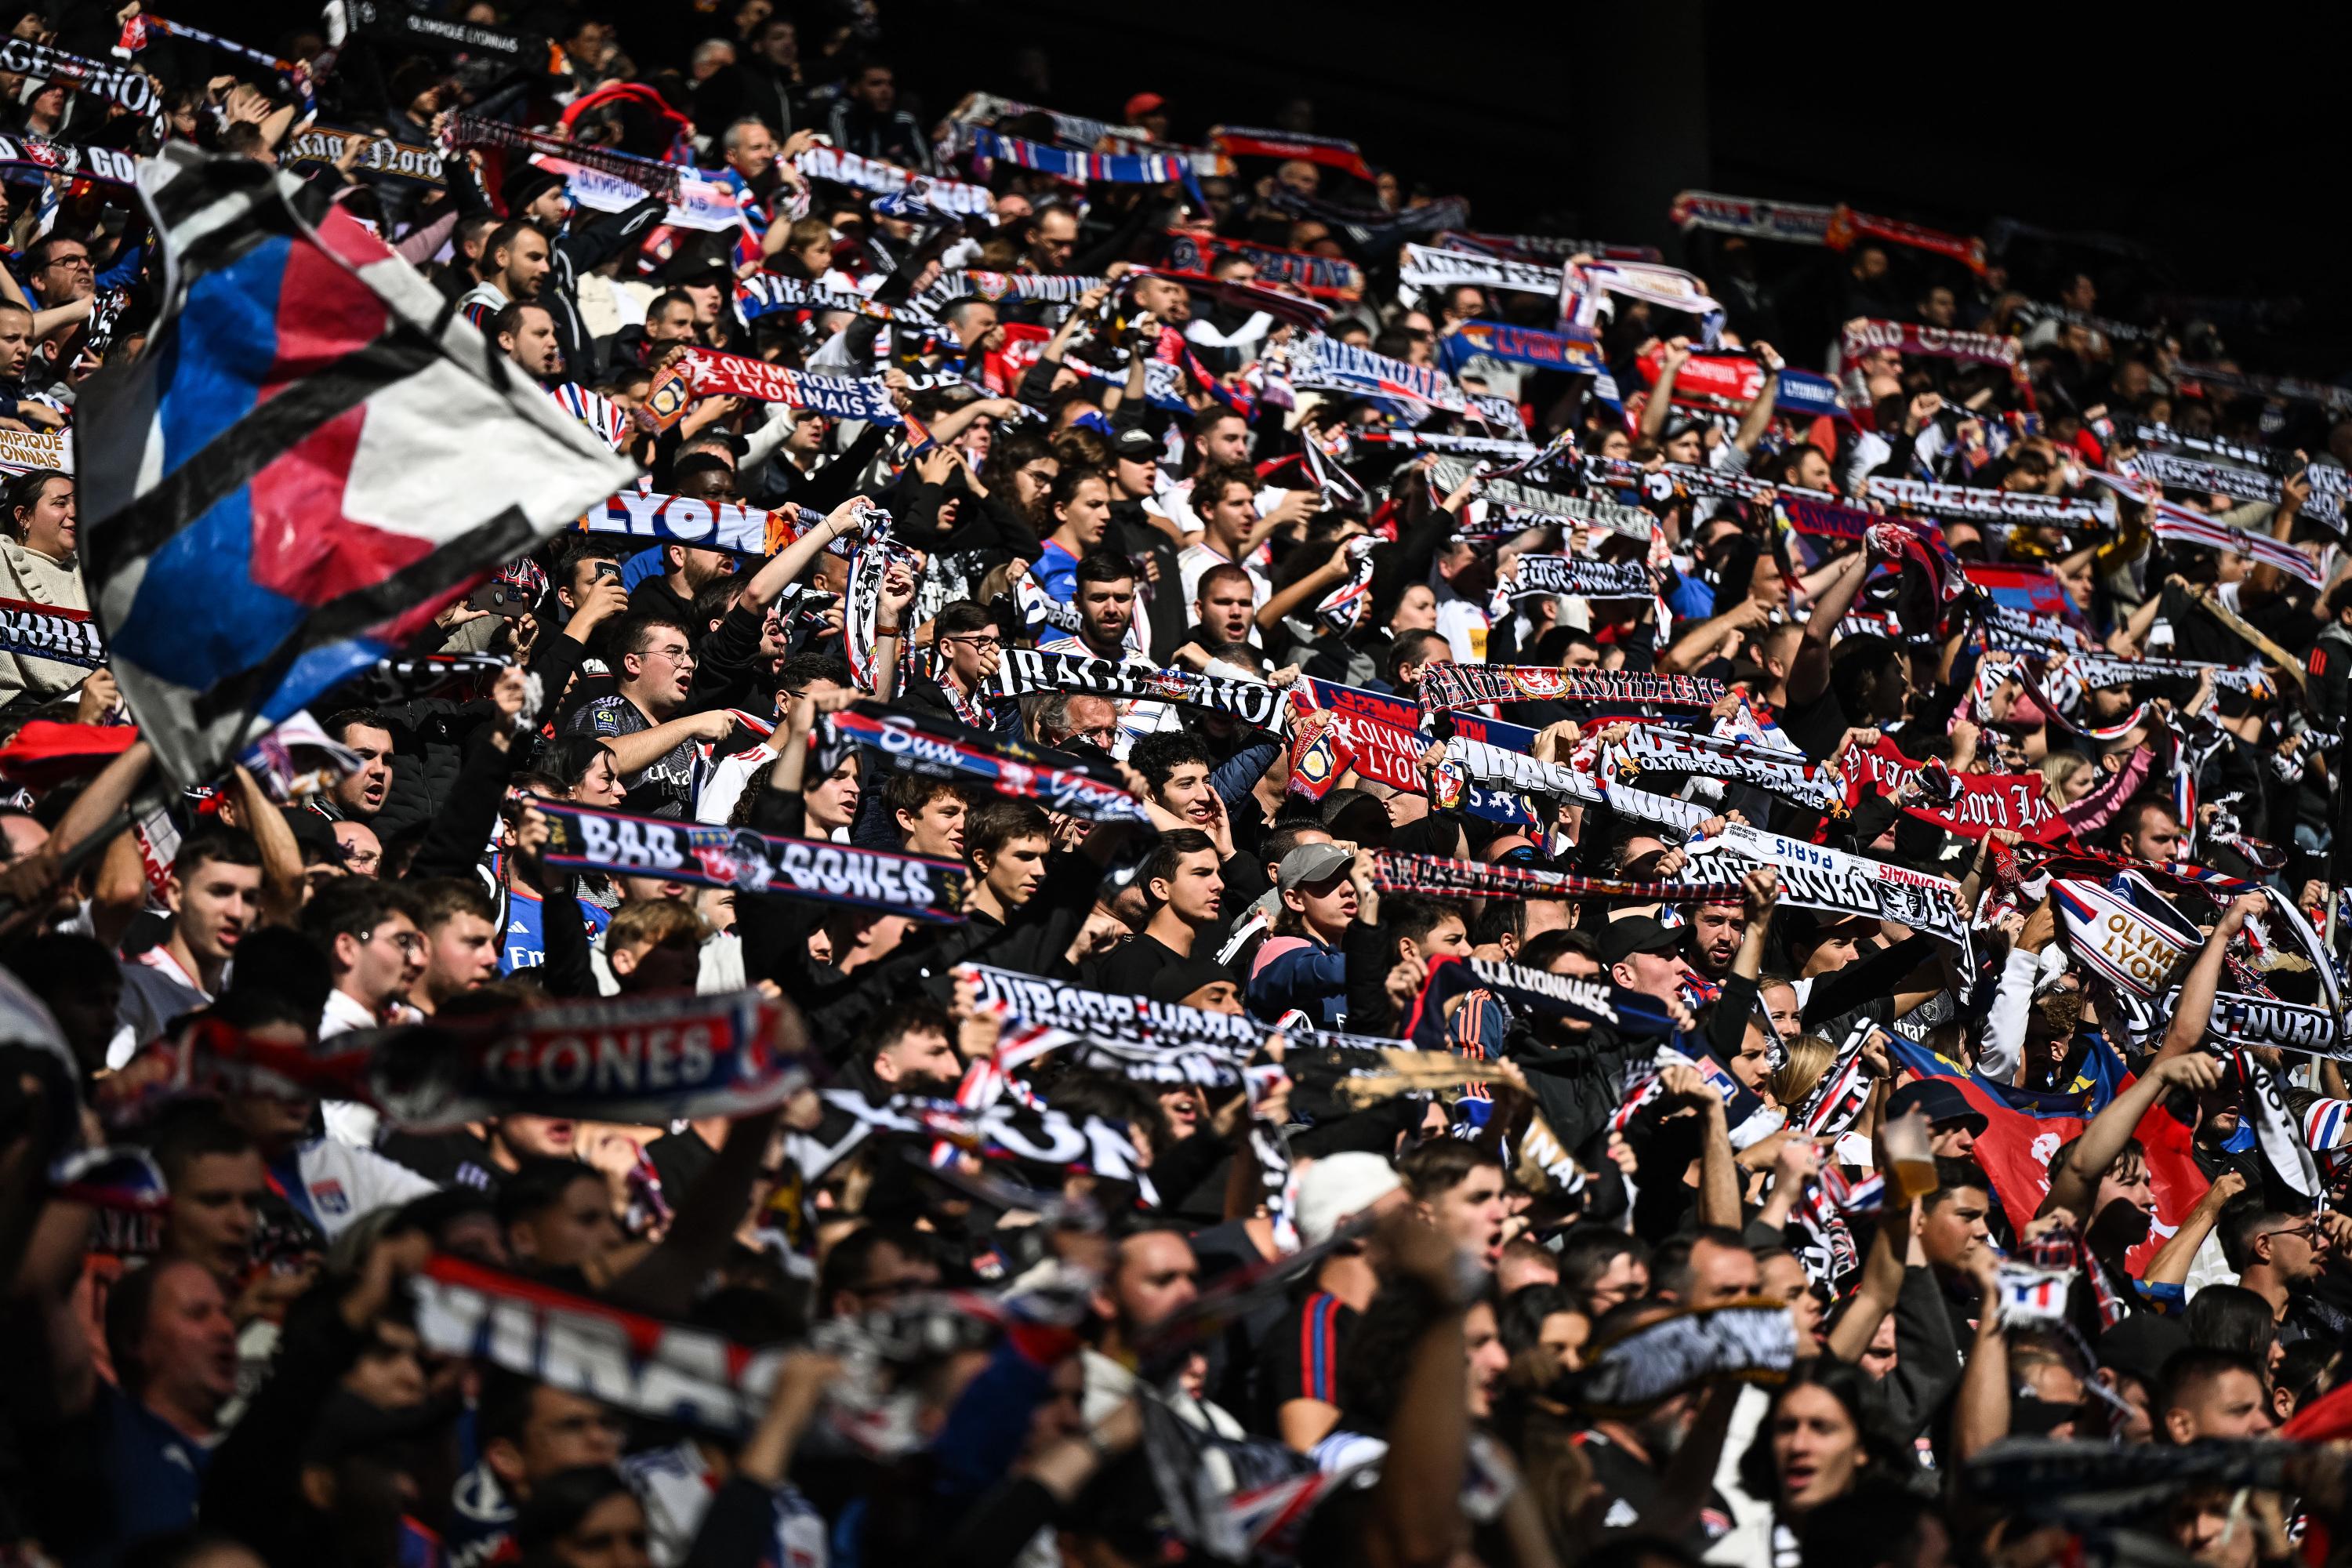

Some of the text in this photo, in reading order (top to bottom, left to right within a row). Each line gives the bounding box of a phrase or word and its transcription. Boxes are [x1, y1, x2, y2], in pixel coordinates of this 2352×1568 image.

[1494, 328, 1563, 363] LYON
[720, 357, 860, 394] OLYMPIQUE
[733, 376, 868, 417] LYONNAIS
[588, 489, 769, 554] LYON
[1640, 756, 1825, 811] OLYMPIQUE LYONNAIS
[579, 813, 685, 869] BAD
[780, 842, 936, 909] GONES
[1776, 838, 1832, 869] PARIS
[1778, 864, 1879, 911] NORD
[483, 1027, 715, 1094] GONES
